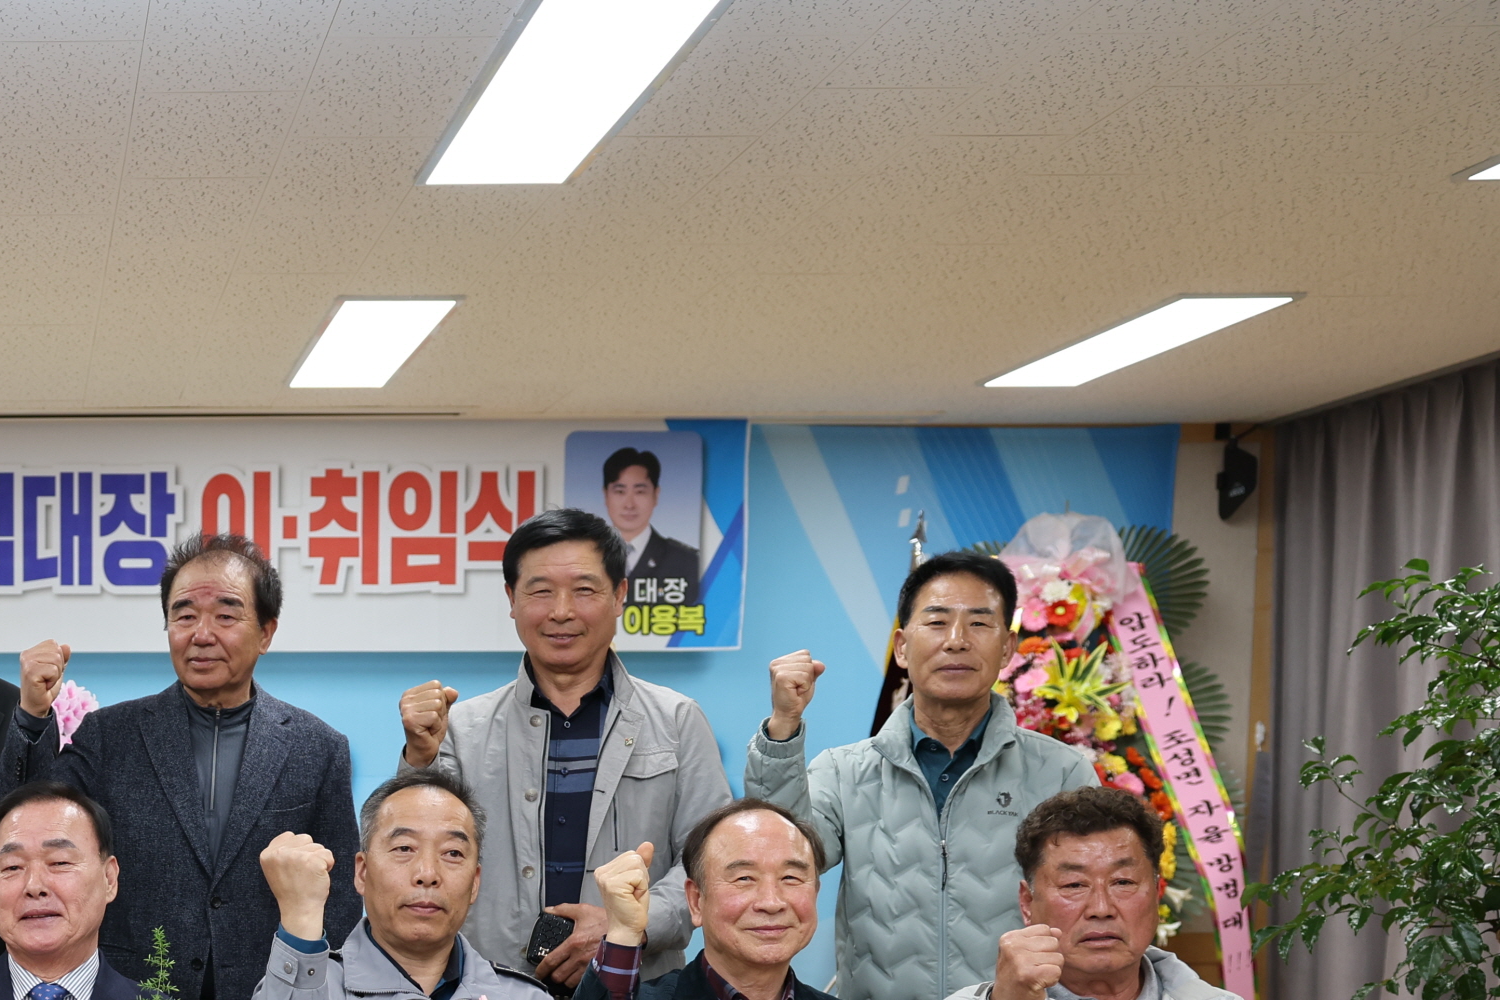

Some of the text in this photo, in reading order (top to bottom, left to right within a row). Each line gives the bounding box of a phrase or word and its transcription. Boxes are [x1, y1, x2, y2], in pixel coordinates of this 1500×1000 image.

[624, 577, 688, 604] 대장
[623, 605, 706, 635] 이용복
[1163, 729, 1205, 785] 조성면
